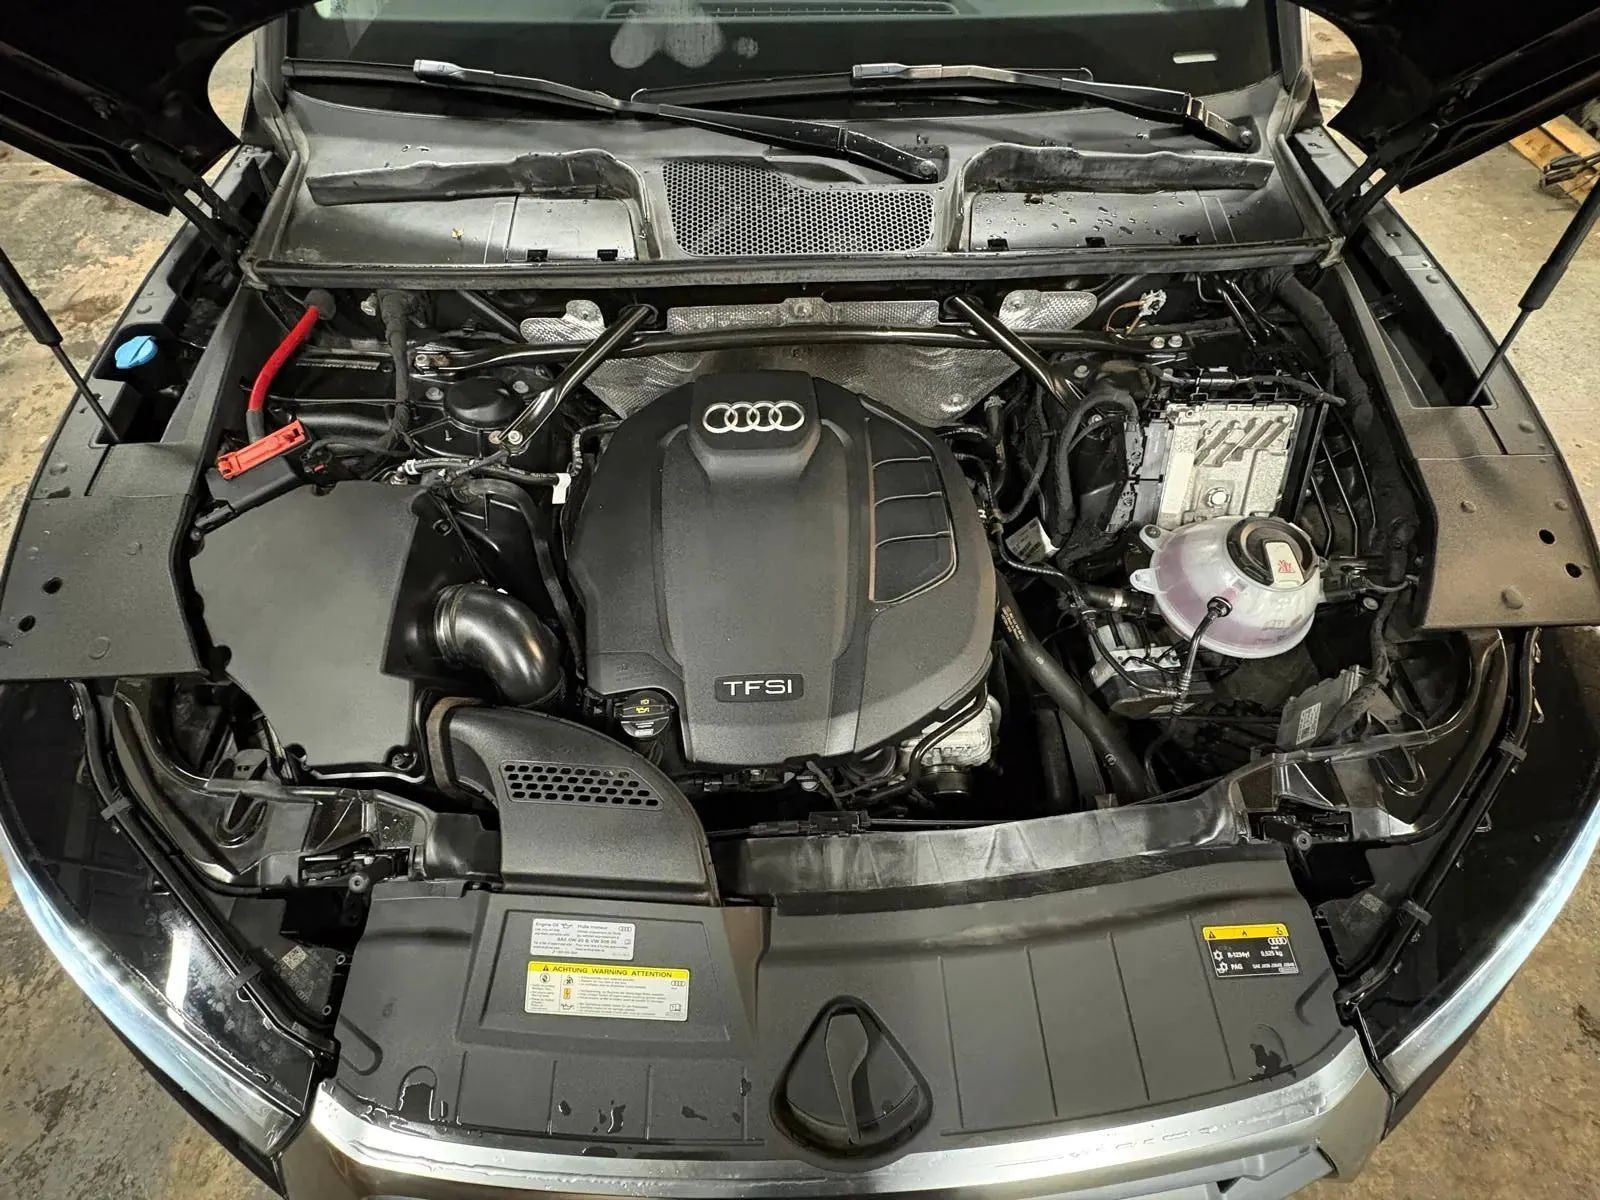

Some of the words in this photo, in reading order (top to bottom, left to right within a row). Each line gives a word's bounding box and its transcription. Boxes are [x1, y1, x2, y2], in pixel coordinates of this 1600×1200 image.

[723, 679, 793, 696] TFSI
[552, 966, 588, 974] ACHTUNG
[591, 968, 628, 976] WARNING
[631, 970, 673, 978] ATTENTION
